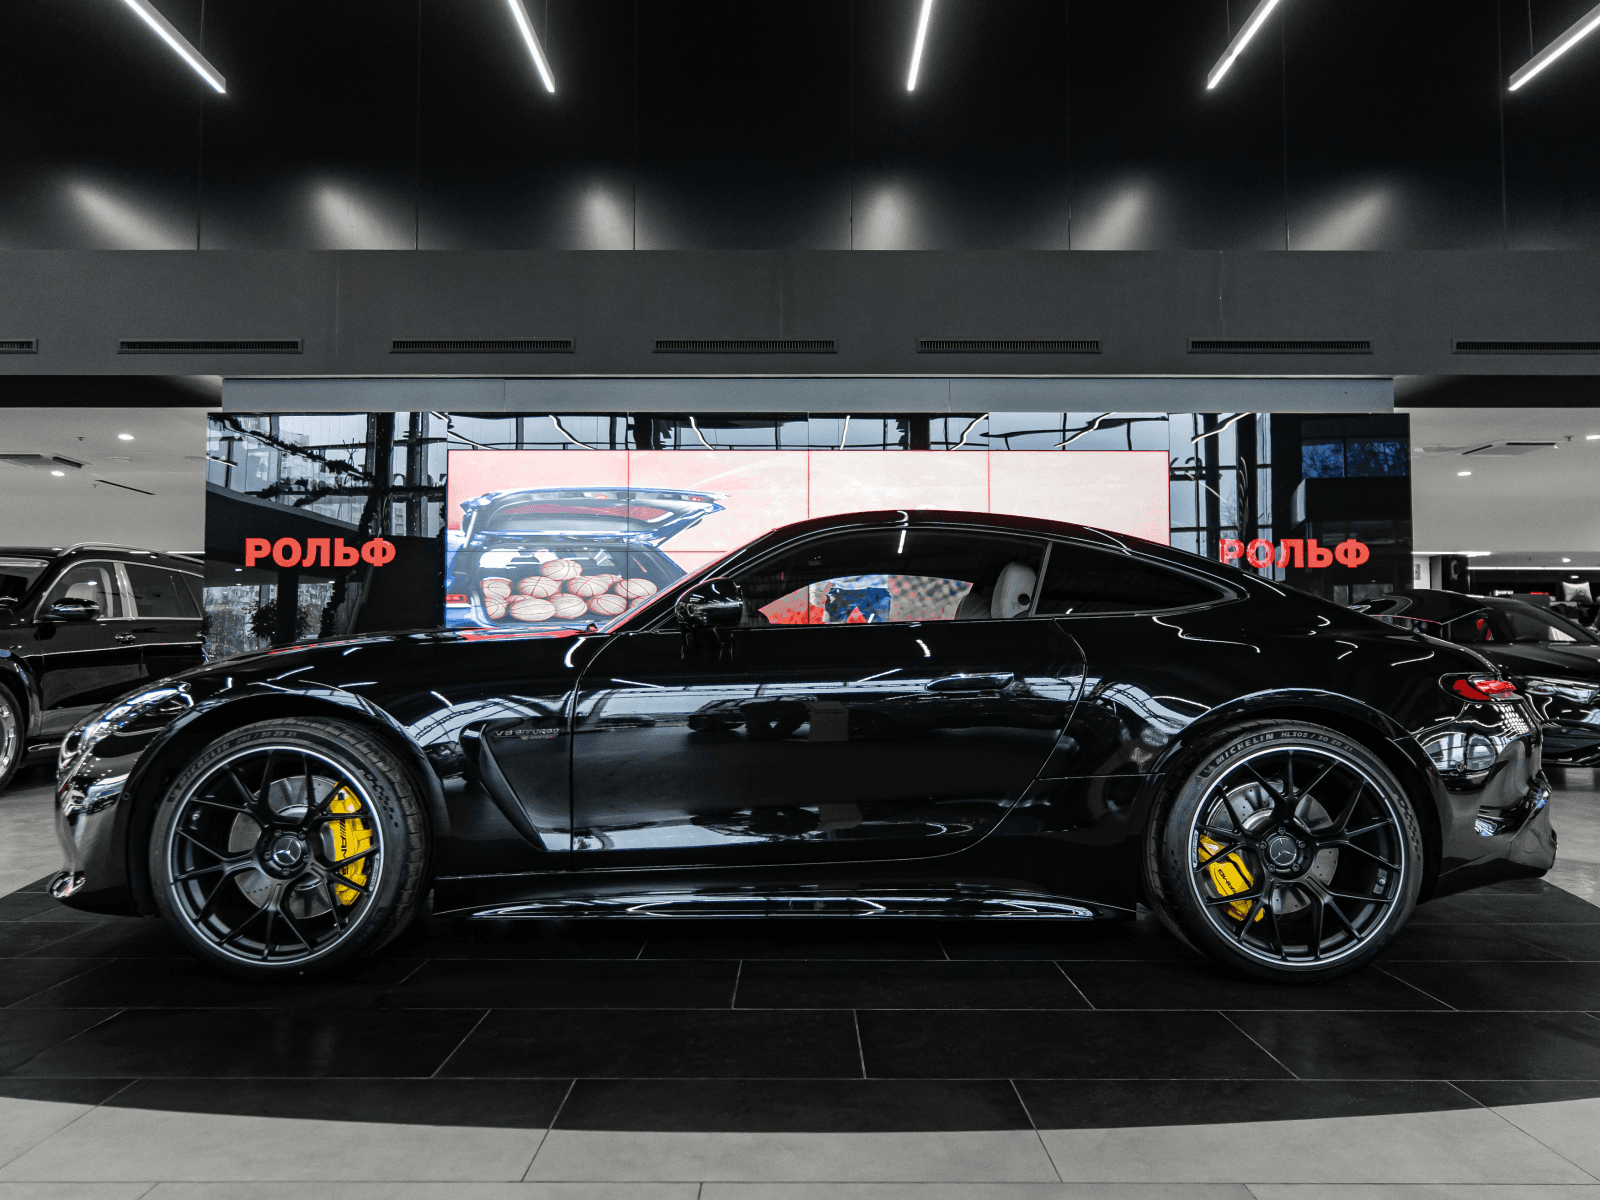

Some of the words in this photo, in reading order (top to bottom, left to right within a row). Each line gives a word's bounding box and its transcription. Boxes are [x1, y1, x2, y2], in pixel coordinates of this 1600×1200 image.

[245, 536, 396, 568] РОЛЬФ
[1218, 537, 1370, 568] РОЛЬФ
[1215, 732, 1274, 764] MICHELIN
[1280, 731, 1309, 739] HL305
[1330, 739, 1342, 747] ZR
[1343, 744, 1353, 752] 21
[179, 741, 231, 788] MICHELIN
[1217, 868, 1235, 890] AMG
